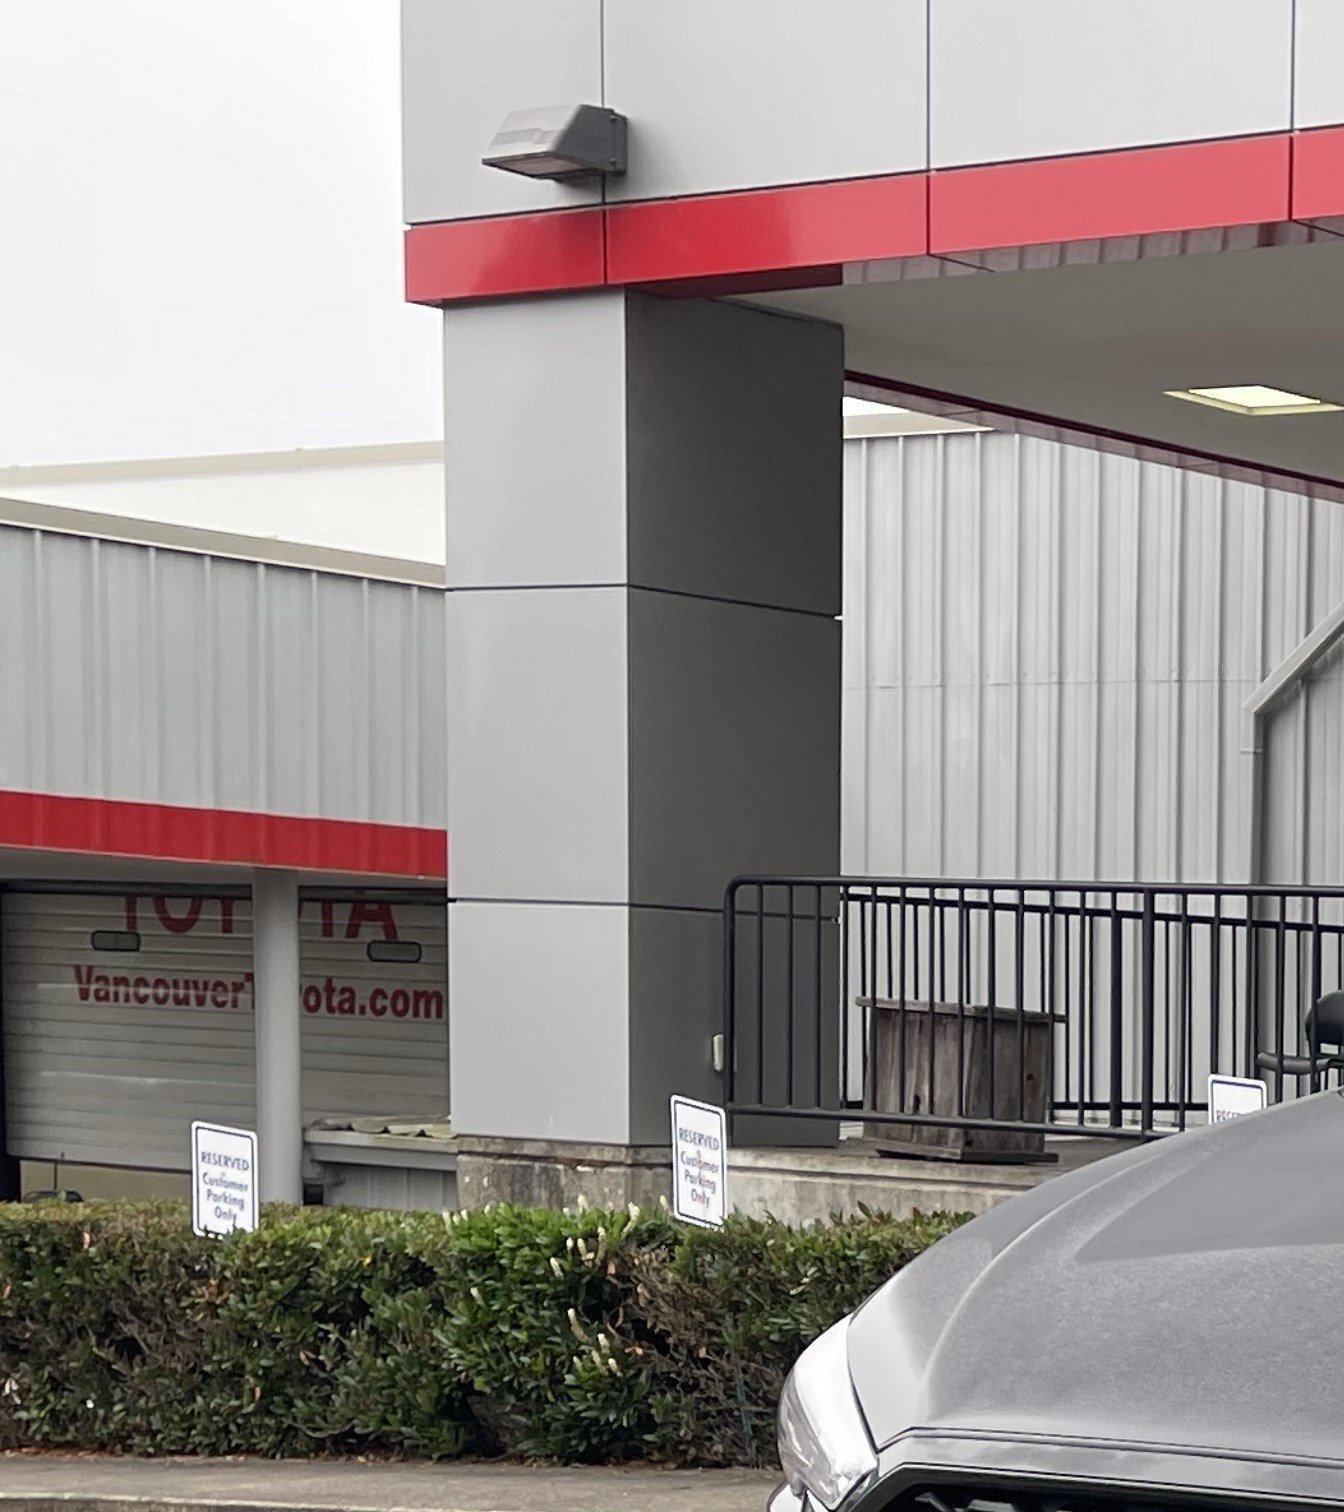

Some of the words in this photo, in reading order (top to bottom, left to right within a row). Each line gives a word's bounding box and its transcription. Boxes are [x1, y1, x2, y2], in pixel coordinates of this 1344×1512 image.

[123, 893, 399, 942] TOYTA
[73, 964, 444, 1019] Vancouverota.com
[679, 1127, 720, 1151] RESERVED
[201, 1151, 249, 1171] RESERVED
[680, 1150, 719, 1174] Customer
[203, 1172, 248, 1192] Customer
[685, 1168, 716, 1195] Parking
[206, 1188, 245, 1212] Parking
[691, 1188, 710, 1209] Only
[214, 1206, 237, 1225] Only
